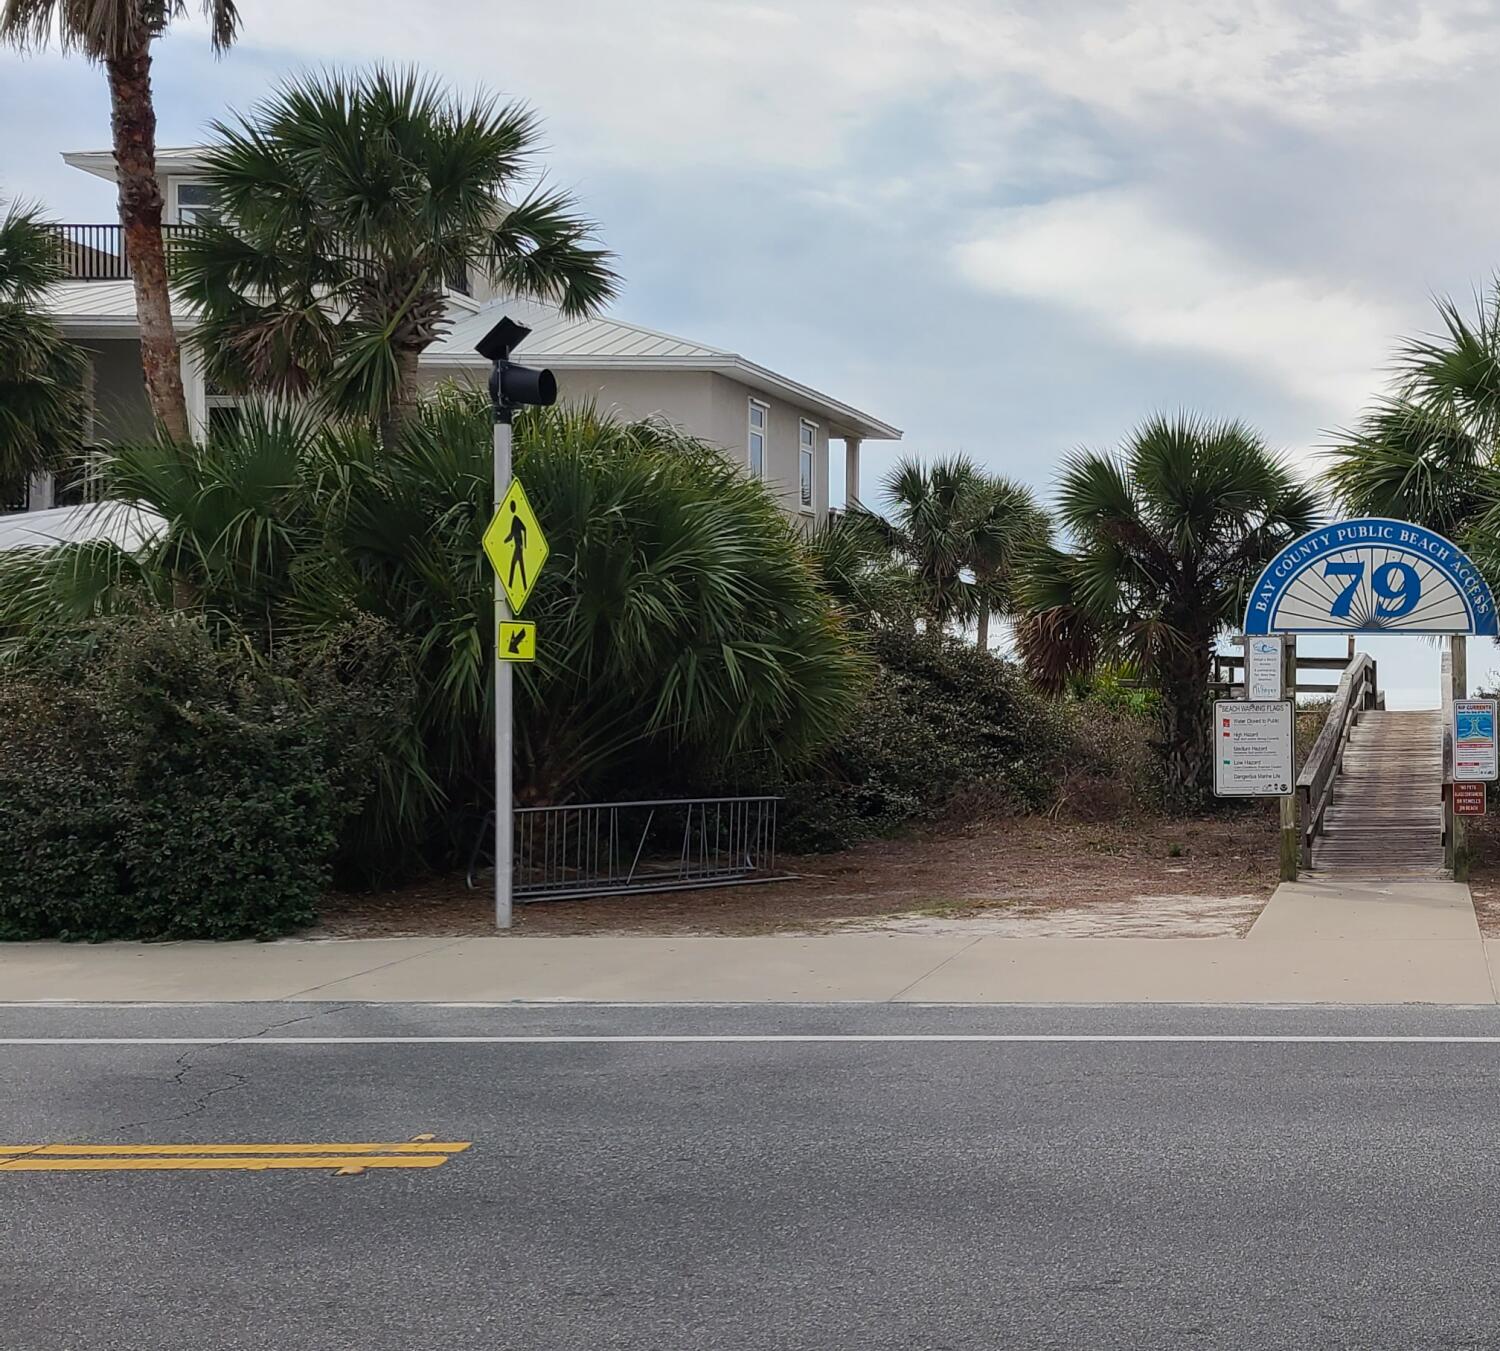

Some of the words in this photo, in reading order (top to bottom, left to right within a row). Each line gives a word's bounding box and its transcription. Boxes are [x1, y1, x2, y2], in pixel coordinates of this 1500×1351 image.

[1256, 579, 1276, 612] BAY
[1275, 533, 1329, 577] COUNTY
[1337, 526, 1393, 541] PUBLIC
[1400, 529, 1450, 561] BEACH
[1450, 561, 1489, 614] ACCESS
[1323, 561, 1421, 618] 79
